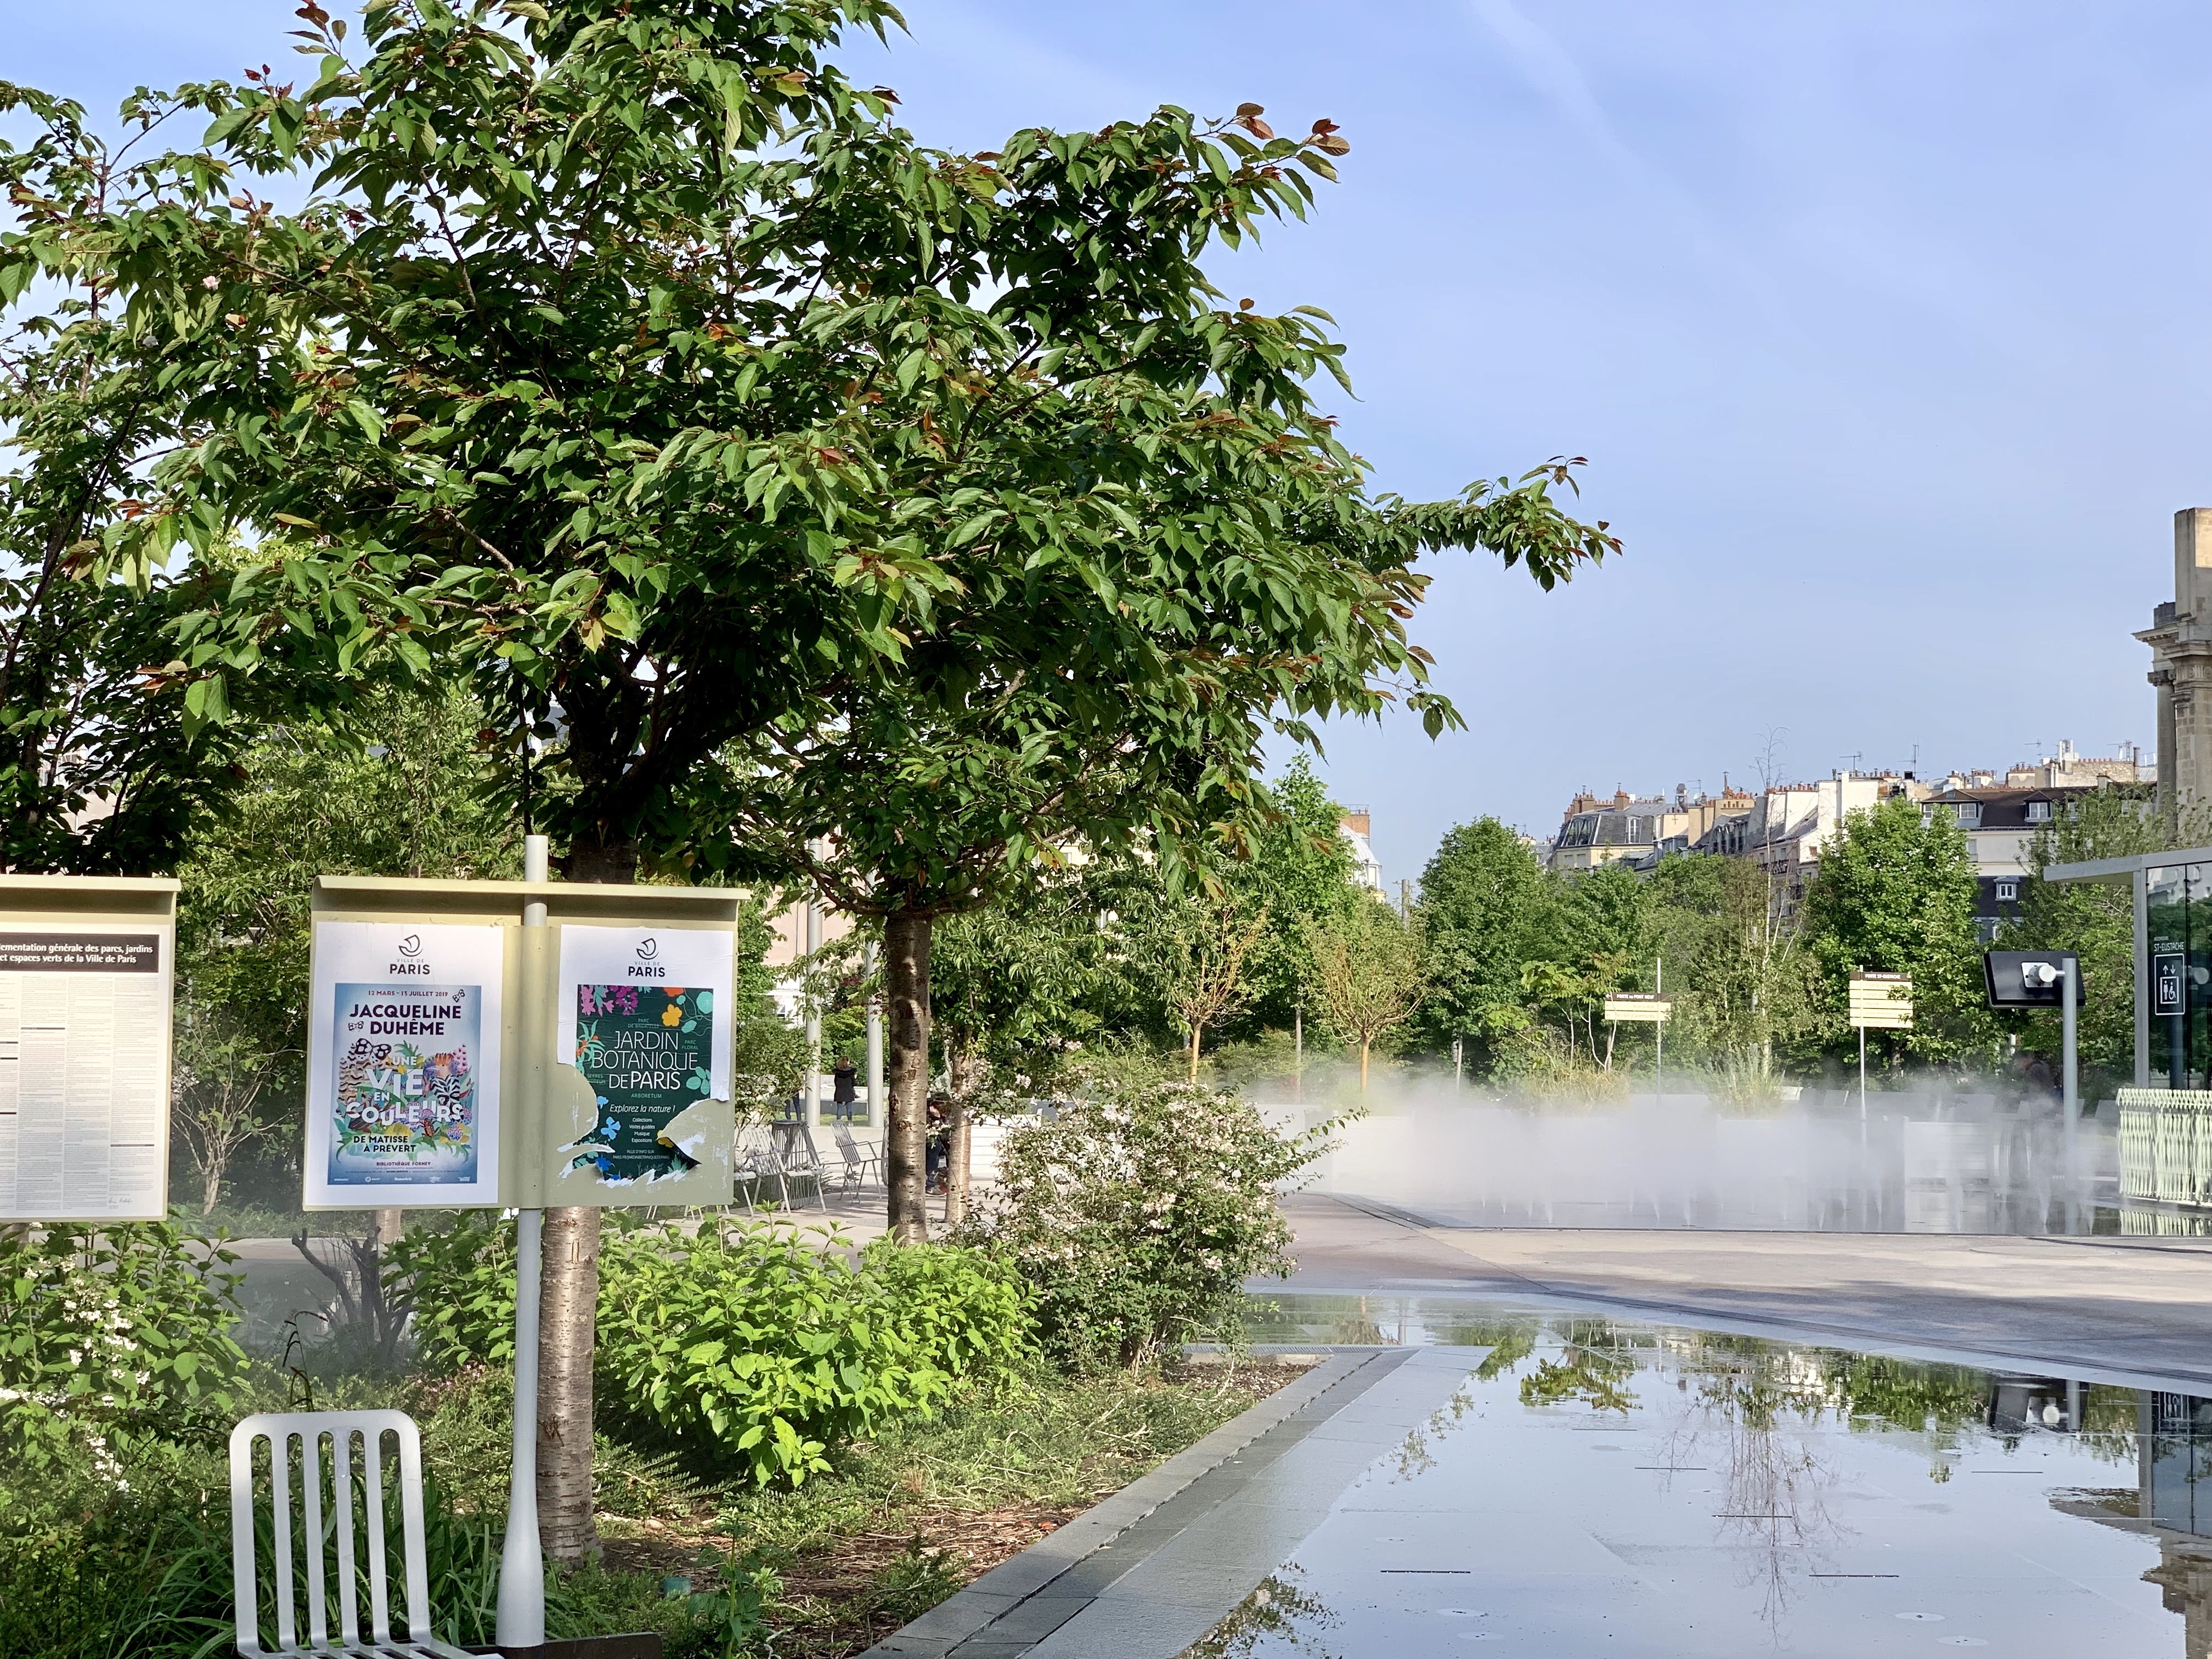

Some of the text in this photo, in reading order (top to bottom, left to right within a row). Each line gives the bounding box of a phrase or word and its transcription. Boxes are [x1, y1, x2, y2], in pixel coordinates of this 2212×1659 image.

[49, 943, 83, 953] générale
[101, 946, 124, 955] parcs,
[125, 945, 153, 955] jardins
[2154, 941, 2184, 952] ST-EUSTACHE
[10, 955, 41, 963] espaces
[86, 955, 104, 963] Ville
[117, 955, 137, 963] Paris
[390, 964, 430, 975] PARIS
[628, 966, 665, 977] PARIS
[349, 1005, 461, 1019] JACQUELINE
[370, 1019, 444, 1035] DUHÊME
[614, 1030, 679, 1050] JARDIN
[393, 1056, 417, 1065] UNE
[592, 1050, 698, 1071] BOTANIQUE
[365, 1069, 423, 1098] VIE
[609, 1071, 681, 1090] DE PARIS
[374, 1092, 390, 1101] EN
[346, 1101, 463, 1126] COULEURS
[610, 1104, 639, 1114] Explorez
[648, 1105, 671, 1113] nature
